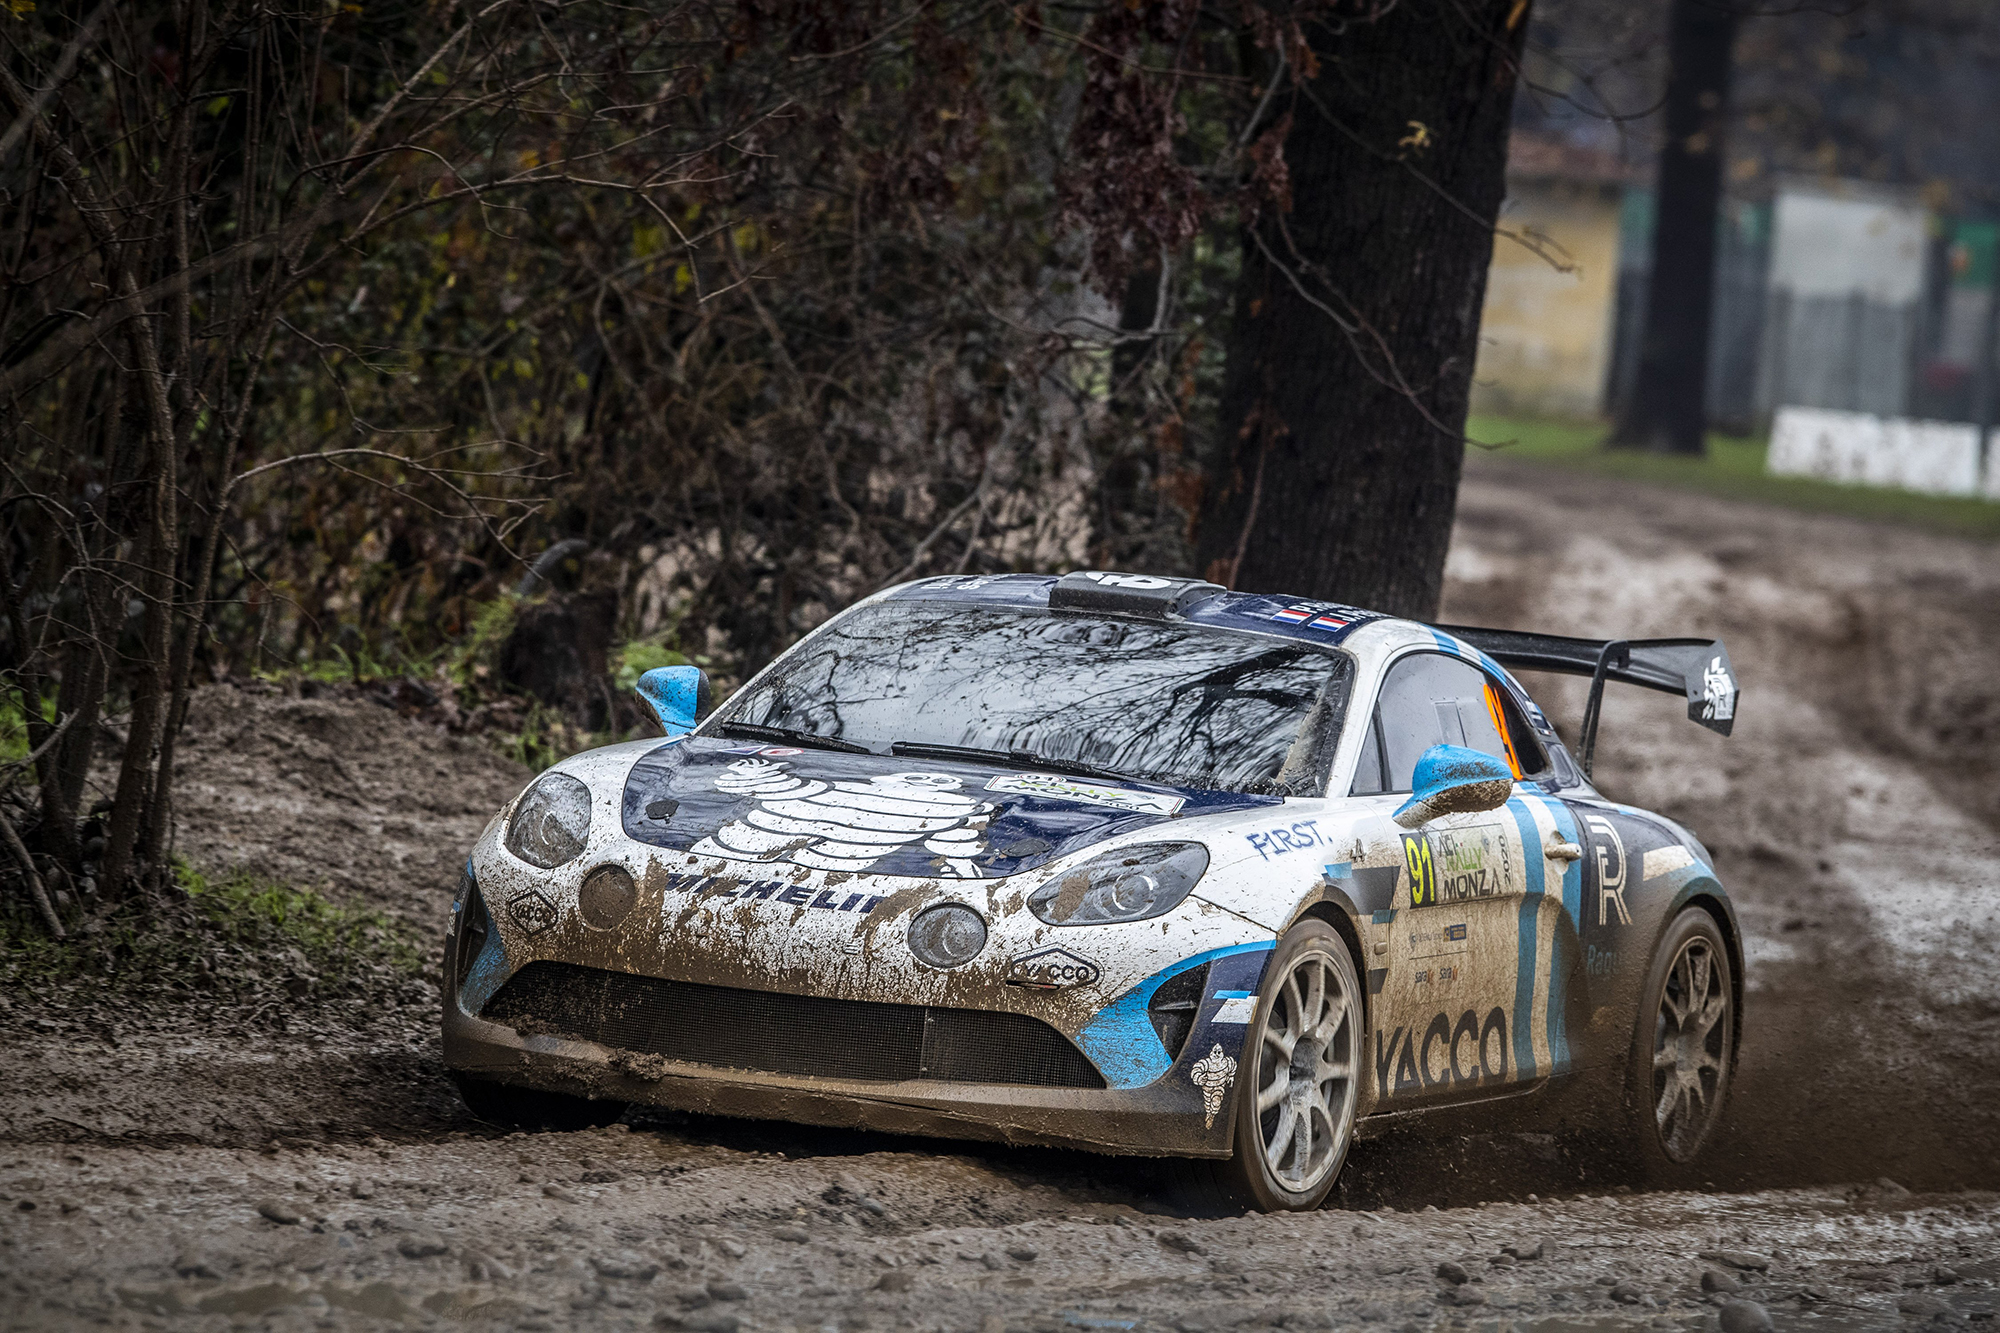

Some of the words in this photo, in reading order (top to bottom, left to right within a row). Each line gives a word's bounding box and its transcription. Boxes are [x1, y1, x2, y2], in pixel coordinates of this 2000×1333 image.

[1002, 785, 1164, 811] MONZA
[1405, 836, 1436, 905] 91
[1446, 846, 1482, 872] RALLY
[1498, 834, 1512, 886] 2020
[1443, 867, 1502, 901] MONZA
[1376, 1005, 1508, 1101] YACCO
